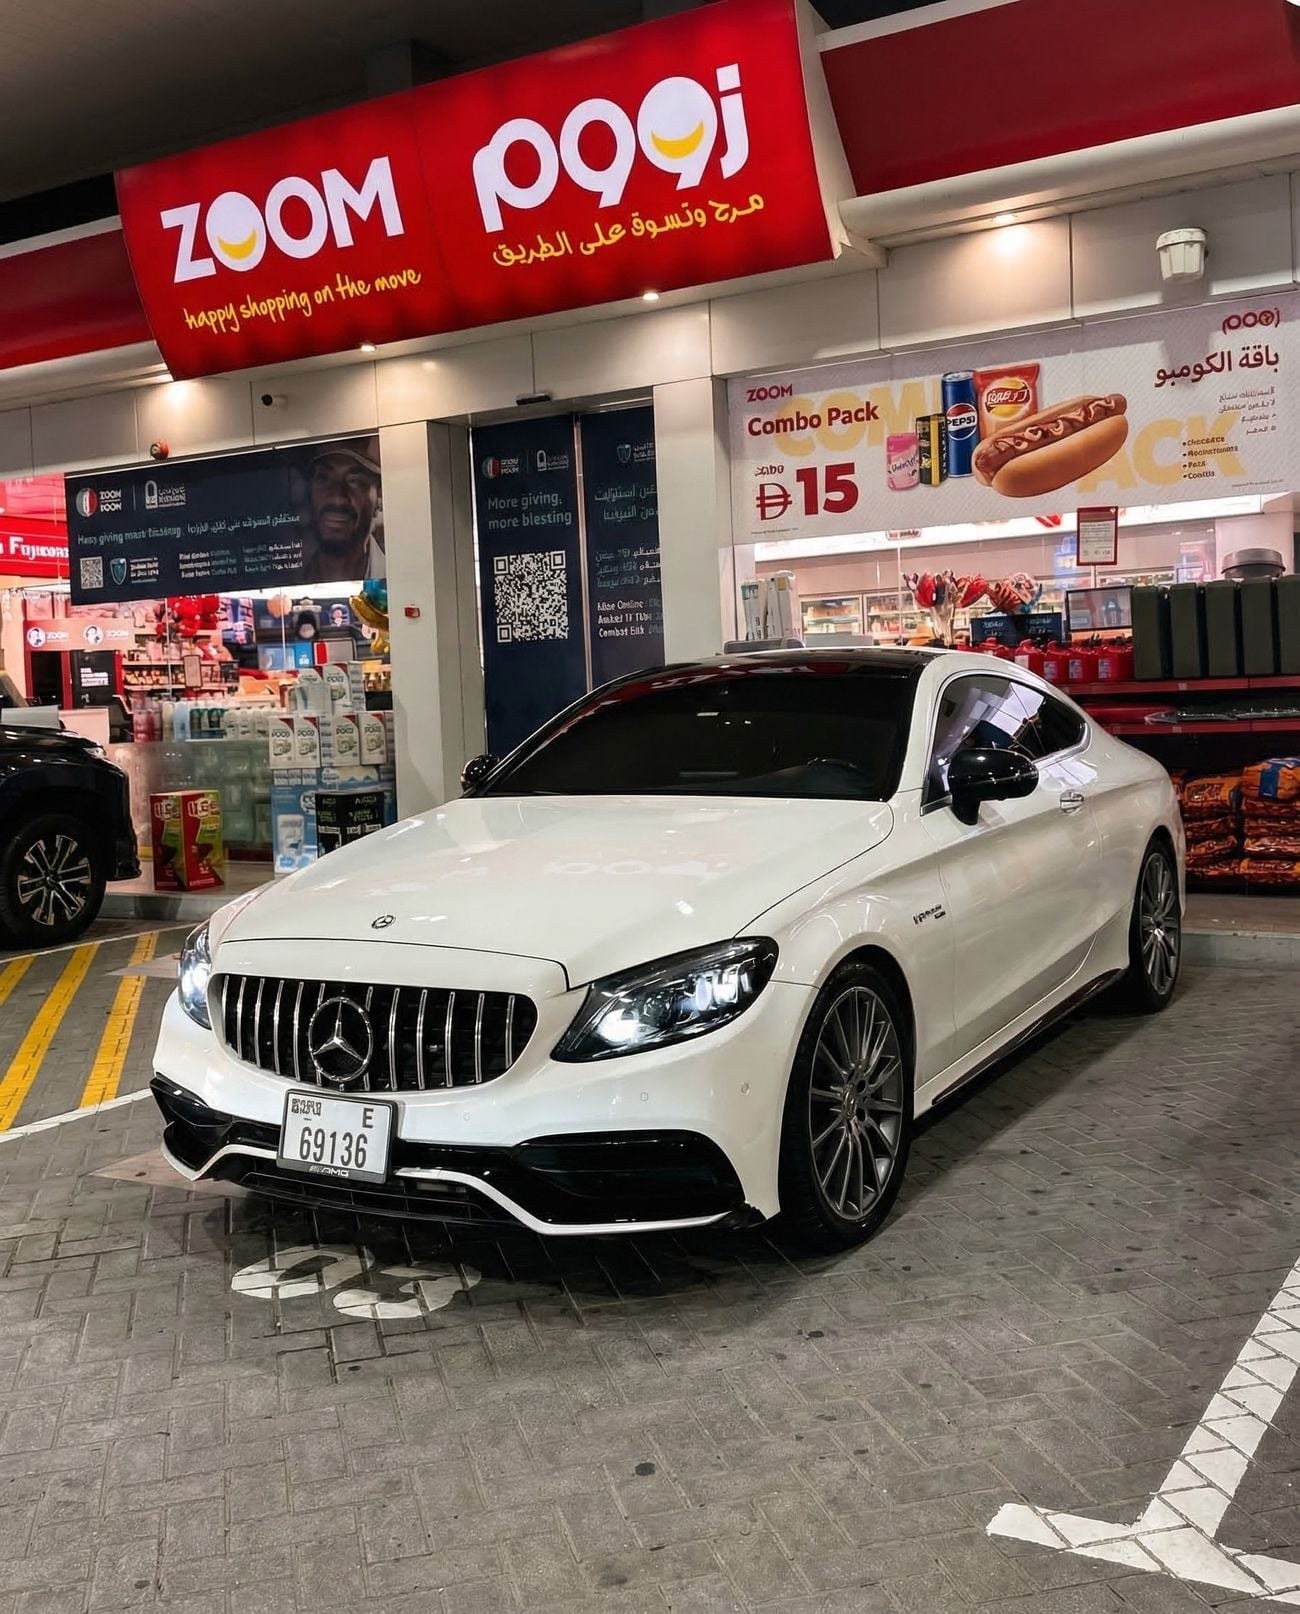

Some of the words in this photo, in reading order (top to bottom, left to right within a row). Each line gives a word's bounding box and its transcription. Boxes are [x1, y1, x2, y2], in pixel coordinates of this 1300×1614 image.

[472, 63, 749, 233] زووم
[160, 156, 404, 284] ZOOM
[631, 202, 706, 239] وتسوق
[709, 193, 764, 223] مرح
[492, 231, 573, 267] الطريق
[579, 222, 626, 255] على
[183, 303, 239, 334] happy
[240, 289, 312, 323] shopping
[315, 285, 334, 304] on
[335, 273, 370, 300] the
[374, 268, 422, 292] move
[1154, 350, 1232, 388] الكومبو
[1238, 345, 1280, 373] باقة
[747, 384, 793, 402] ZOOM
[748, 413, 822, 437] Combo
[827, 401, 880, 427] Pack
[488, 497, 518, 510] More
[796, 462, 859, 516] 15
[488, 517, 520, 530] more
[362, 1108, 374, 1129] E
[299, 1126, 368, 1169] 69136
